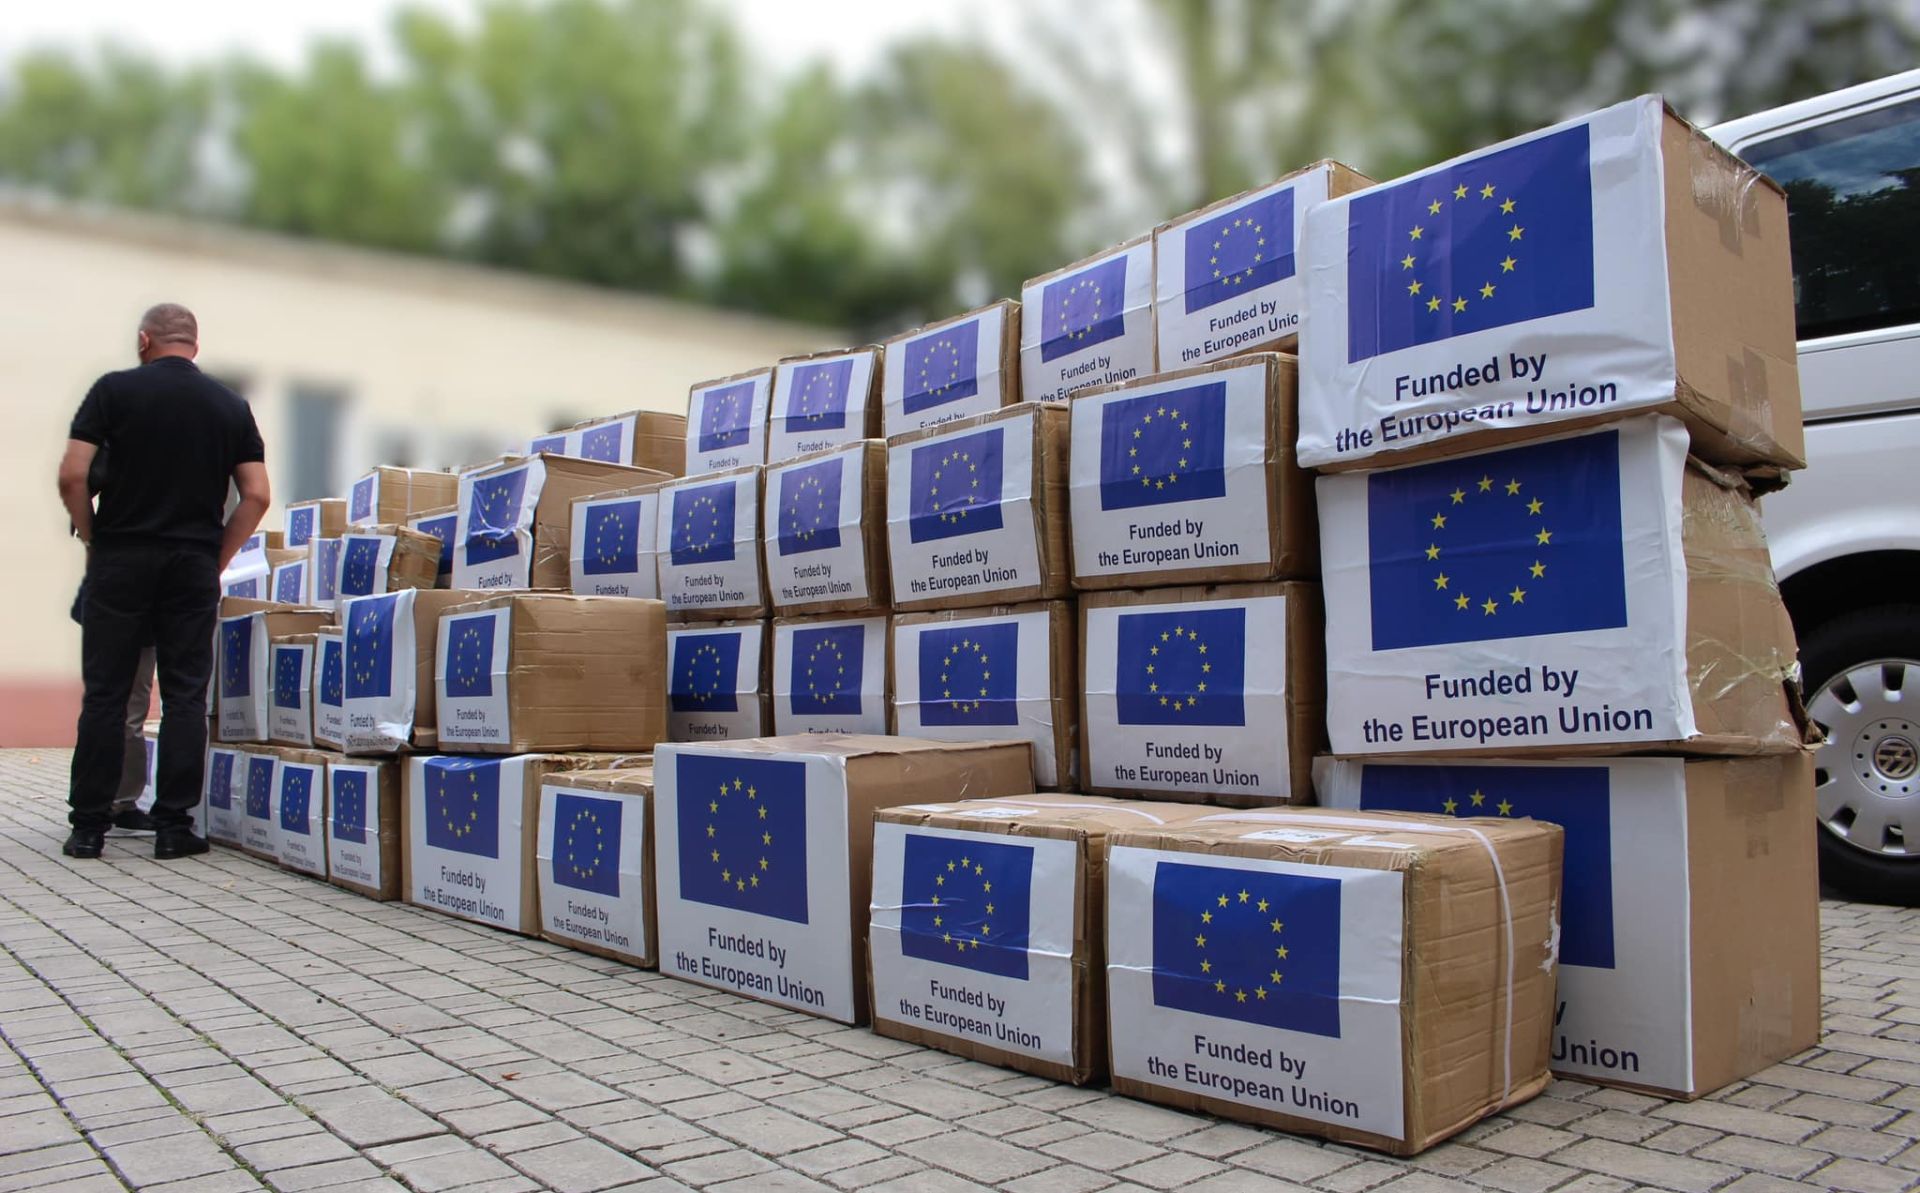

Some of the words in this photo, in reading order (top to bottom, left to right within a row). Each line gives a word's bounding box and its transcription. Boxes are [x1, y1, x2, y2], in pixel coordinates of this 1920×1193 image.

[1209, 305, 1258, 332] Funded
[1260, 300, 1277, 315] by
[1182, 347, 1201, 362] the
[1204, 324, 1265, 354] European
[1268, 314, 1299, 332] Unio
[1060, 358, 1096, 380] Funded
[1098, 356, 1110, 369] by
[1395, 357, 1500, 400] Funded
[1510, 353, 1546, 382] by
[1041, 393, 1055, 402] the
[1105, 367, 1136, 384] Union
[1336, 427, 1373, 453] the
[1380, 401, 1514, 442] European
[1526, 382, 1617, 414] Union
[798, 441, 822, 452] Funded
[709, 459, 730, 469] Funded
[732, 458, 739, 466] by
[1129, 520, 1181, 540] Funded
[1185, 519, 1204, 538] by
[932, 550, 973, 568] Funded
[976, 548, 989, 564] by
[1098, 551, 1119, 567] the
[1123, 544, 1190, 565] European
[1194, 540, 1239, 558] Union
[478, 574, 503, 588] Funded
[504, 573, 512, 586] by
[685, 575, 712, 587] Funded
[714, 575, 724, 587] by
[793, 565, 819, 579] Funded
[820, 564, 831, 577] by
[911, 579, 927, 593] the
[929, 572, 980, 591] European
[983, 566, 1017, 583] Union
[595, 585, 619, 594] Funded
[620, 585, 629, 596] by
[671, 594, 683, 605] the
[683, 592, 718, 605] European
[719, 590, 744, 601] Union
[782, 588, 792, 598] the
[793, 583, 827, 598] European
[829, 581, 852, 593] Union
[1425, 667, 1532, 700] Funded
[1542, 665, 1579, 698] by
[457, 709, 478, 720] Funded
[479, 709, 485, 723] by
[1363, 719, 1403, 743] the
[1412, 714, 1548, 744] European
[1559, 704, 1653, 733] Union
[455, 726, 481, 740] European
[482, 726, 499, 737] Union
[689, 723, 717, 734] Funded
[719, 725, 728, 737] by
[1146, 742, 1200, 759] Funded
[1204, 744, 1223, 764] by
[1115, 765, 1136, 780] the
[1139, 766, 1209, 786] European
[1213, 770, 1260, 786] Union
[441, 866, 473, 887] Funded
[474, 874, 486, 893] by
[424, 885, 435, 902] the
[438, 889, 477, 913] European
[479, 901, 505, 921] Union
[568, 900, 597, 920] Funded
[598, 906, 609, 925] by
[553, 916, 564, 930] the
[565, 919, 602, 940] European
[604, 927, 629, 947] Union
[708, 928, 764, 960] Funded
[768, 945, 786, 968] by
[676, 951, 698, 973] the
[702, 956, 773, 994] European
[777, 974, 825, 1007] Union
[930, 980, 984, 1008] Funded
[987, 994, 1006, 1017] by
[899, 999, 921, 1019] the
[924, 1004, 993, 1038] European
[996, 1023, 1042, 1050] Union
[1194, 1034, 1273, 1073] Funded
[1279, 1053, 1306, 1080] by
[1147, 1055, 1179, 1080] the
[1184, 1062, 1285, 1103] European
[1291, 1084, 1360, 1119] Union
